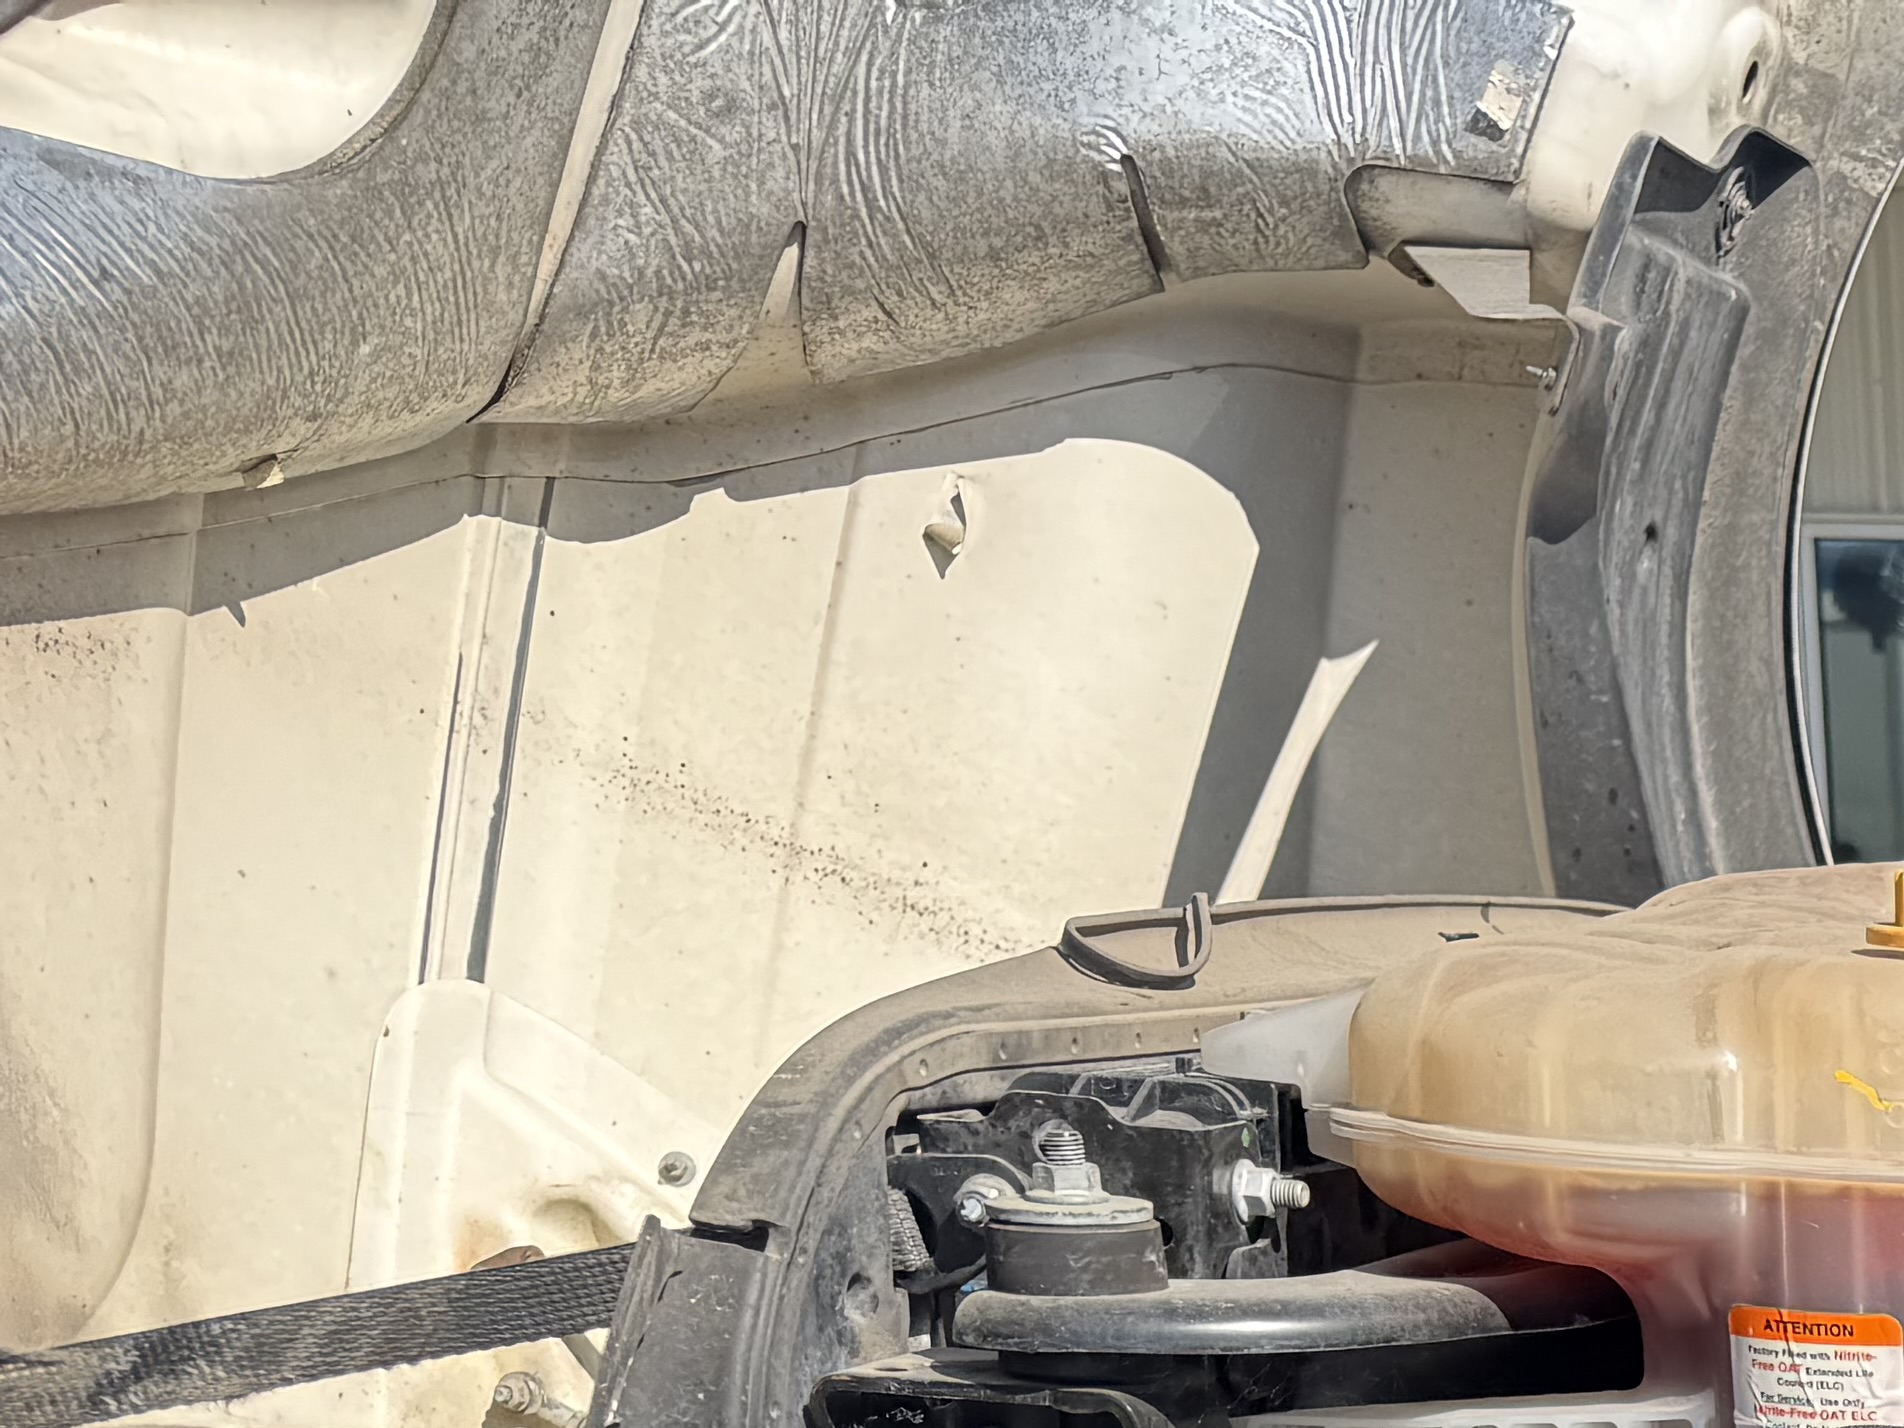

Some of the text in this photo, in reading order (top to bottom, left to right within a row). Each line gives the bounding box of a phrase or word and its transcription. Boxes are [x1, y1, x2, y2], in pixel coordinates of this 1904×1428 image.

[1764, 1319, 1854, 1337] ATTENTION
[1820, 1410, 1847, 1421] OAT
[1851, 1410, 1877, 1421] ELC
